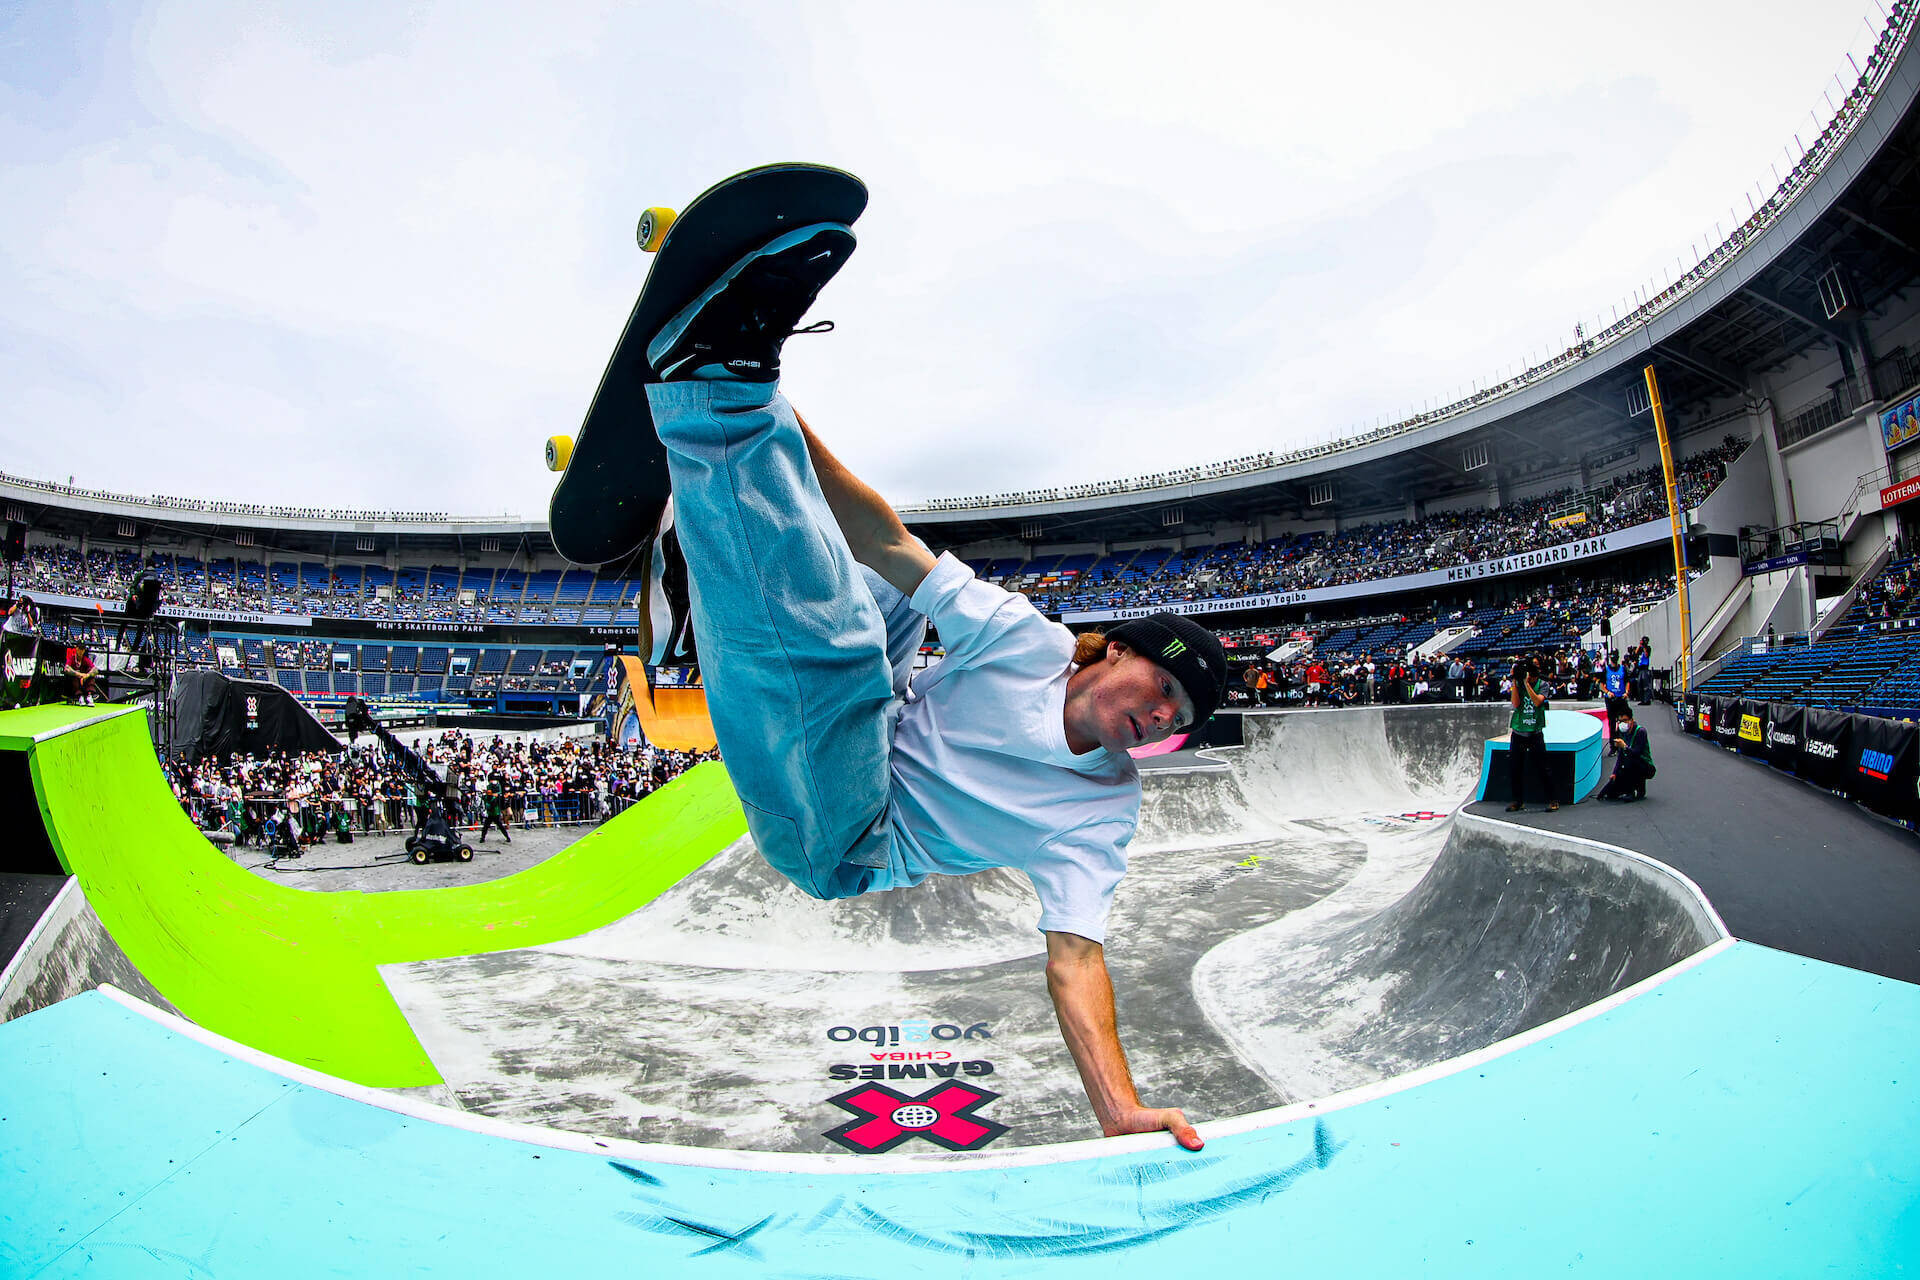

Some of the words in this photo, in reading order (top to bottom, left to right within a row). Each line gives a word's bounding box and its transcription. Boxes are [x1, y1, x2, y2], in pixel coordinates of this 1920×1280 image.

[1883, 482, 1920, 504] LOTTERIA
[1448, 564, 1484, 581] MEN'S
[1489, 548, 1568, 573] SKATEBOARD
[1573, 538, 1608, 557] PARK
[168, 608, 185, 616] 2022
[188, 609, 225, 619] Presented
[228, 612, 236, 622] by
[239, 613, 264, 622] Yogibo
[1121, 609, 1150, 618] Games
[1183, 604, 1204, 614] 2022
[1208, 599, 1257, 611] Presented
[1260, 597, 1271, 607] by
[1274, 593, 1307, 605] Yogibo
[376, 622, 402, 630] MEN'S
[405, 623, 459, 632] SKATEBOARD
[1860, 748, 1894, 773] HIBINO
[827, 1019, 992, 1047] yogibo
[870, 1051, 952, 1061] CHIBA
[828, 1060, 994, 1080] GAMES
